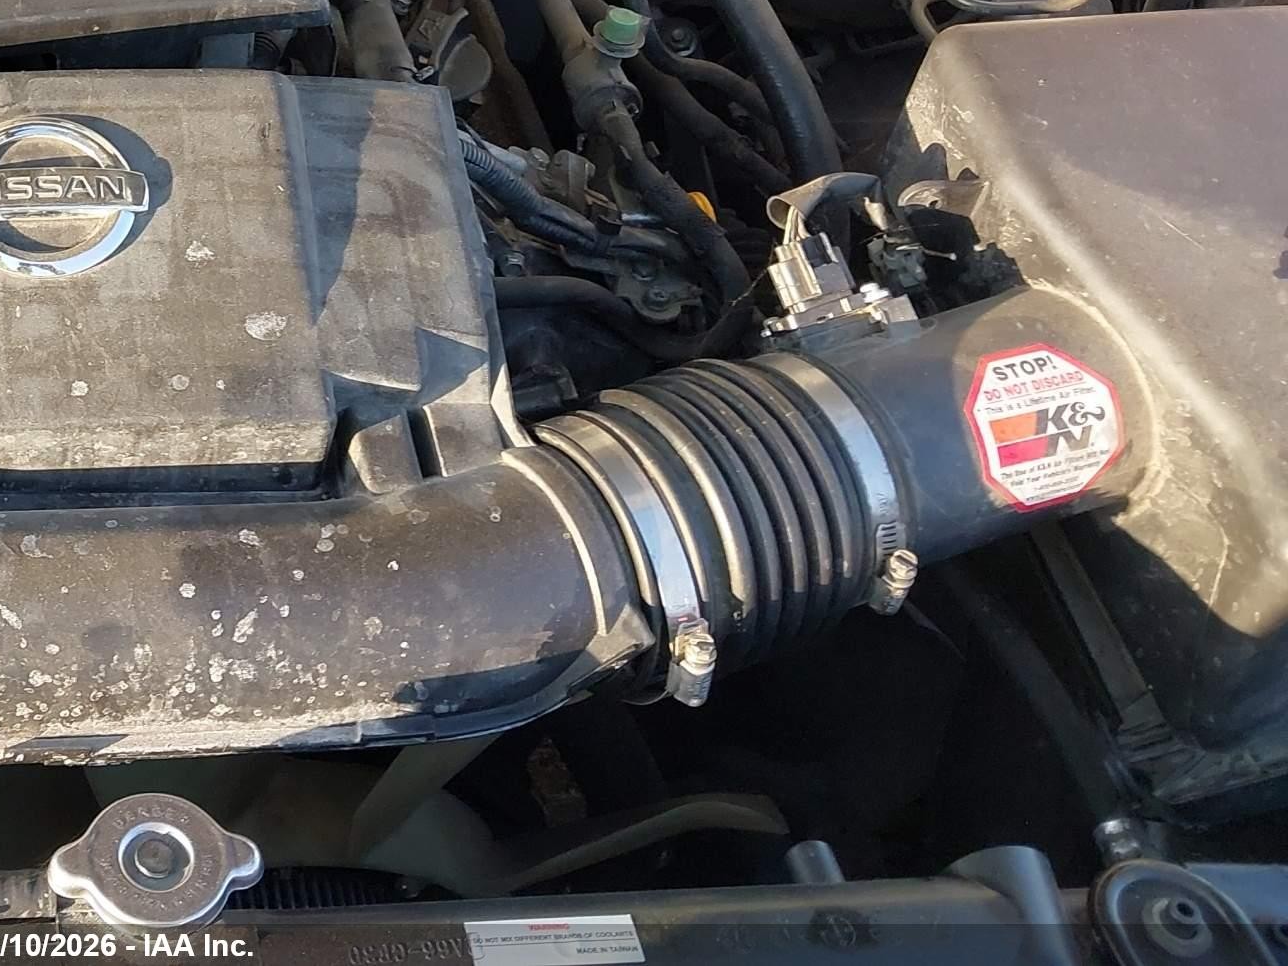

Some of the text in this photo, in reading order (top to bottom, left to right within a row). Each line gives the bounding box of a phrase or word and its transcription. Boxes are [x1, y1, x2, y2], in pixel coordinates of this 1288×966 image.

[992, 355, 1057, 381] STOP!
[984, 371, 1084, 401] DO NOT DISCARD
